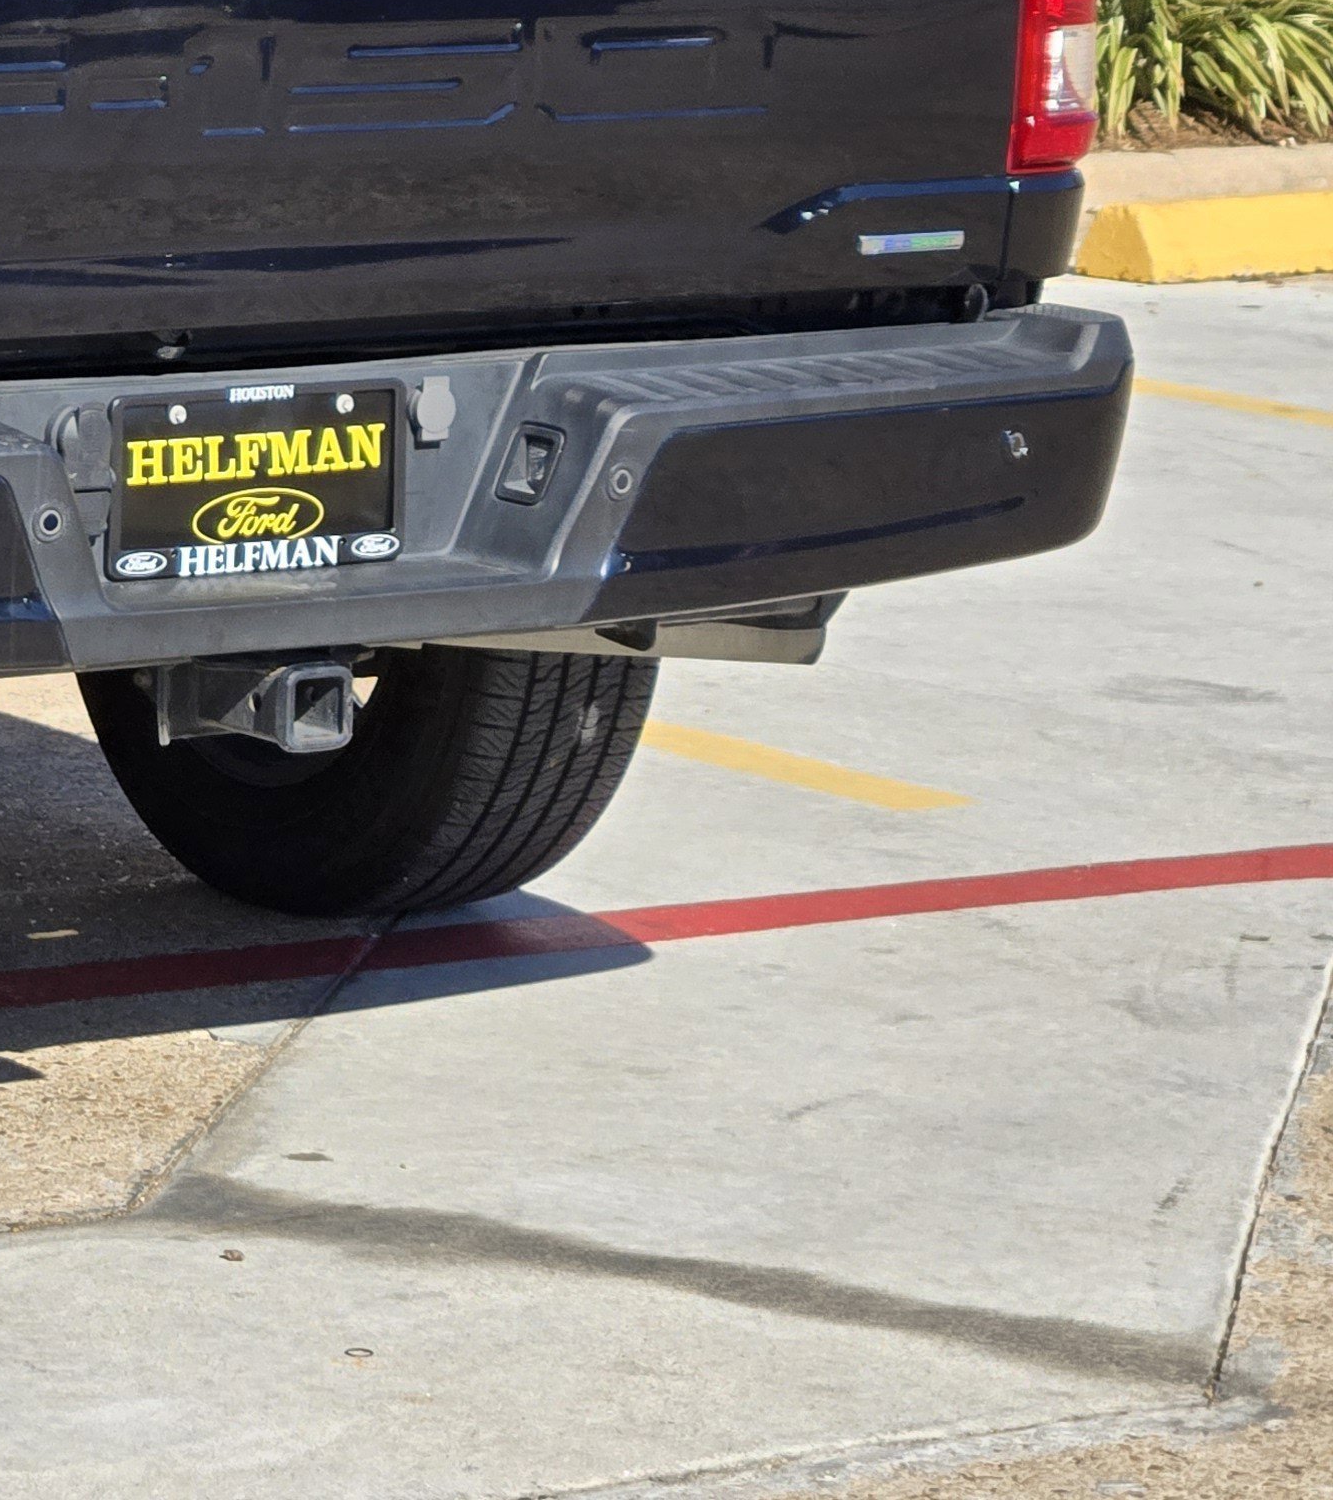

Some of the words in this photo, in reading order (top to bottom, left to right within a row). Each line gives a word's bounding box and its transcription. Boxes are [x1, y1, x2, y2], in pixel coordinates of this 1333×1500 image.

[230, 384, 295, 403] HOUSTON
[126, 423, 386, 487] HELFMAN
[217, 496, 297, 539] Ford
[178, 535, 342, 577] HELFMAN
